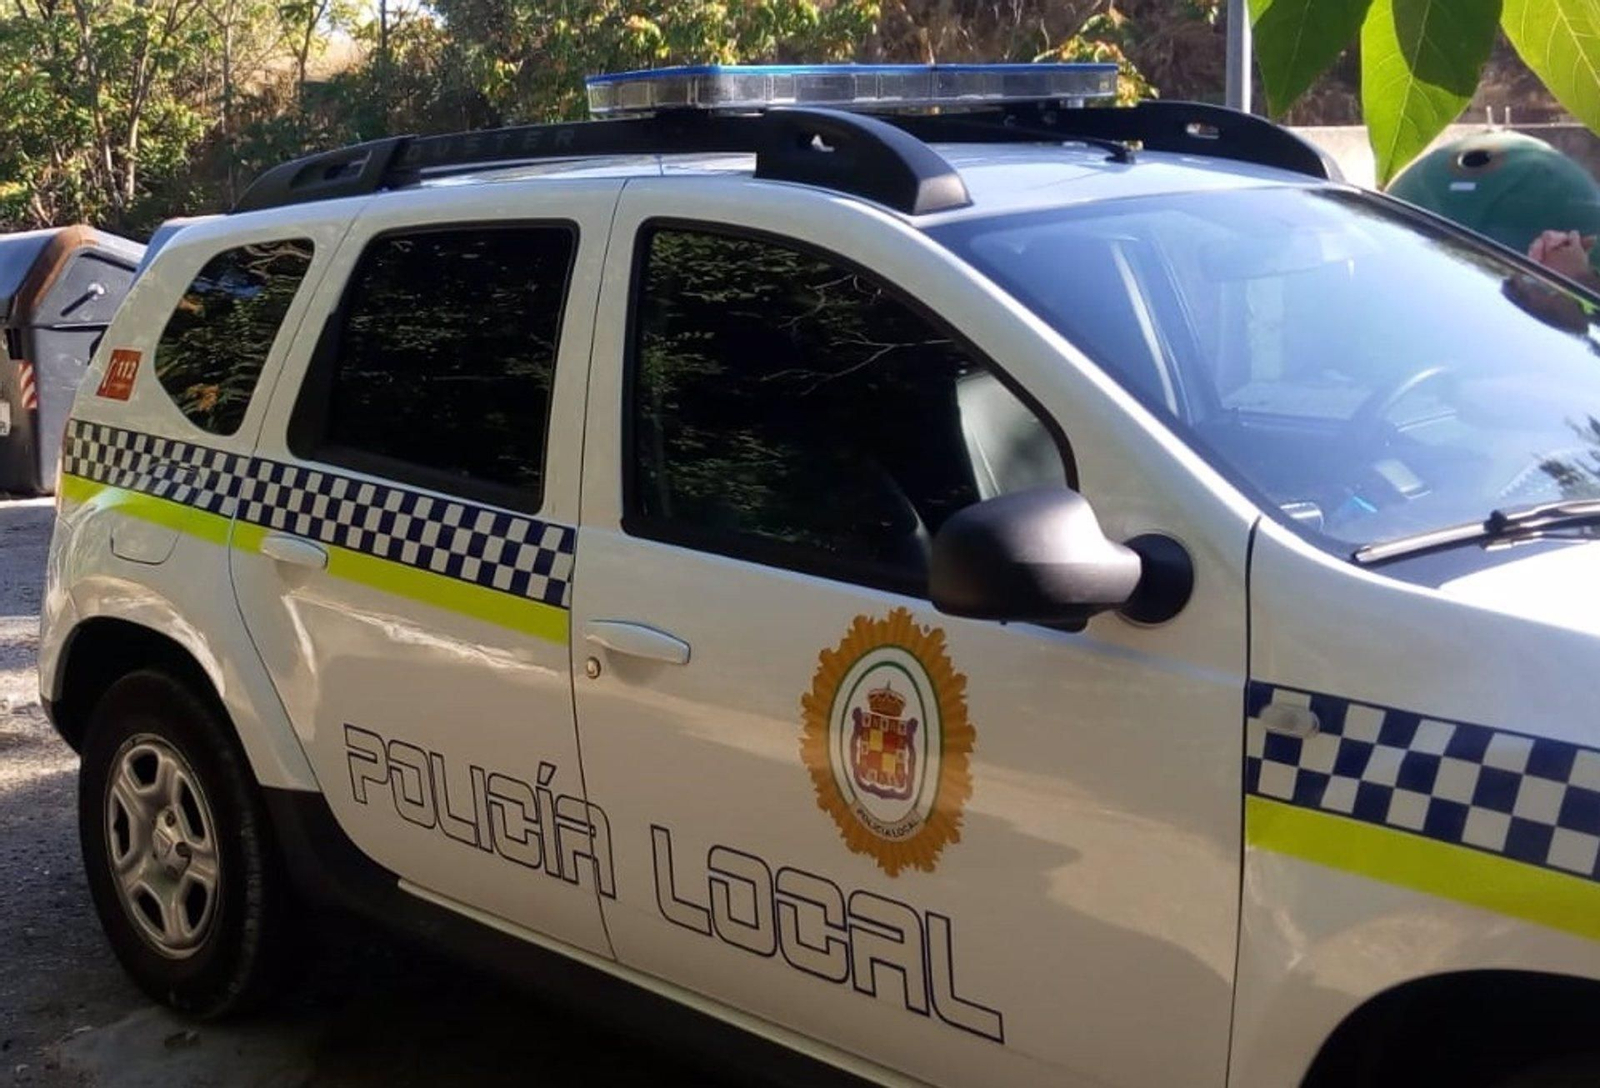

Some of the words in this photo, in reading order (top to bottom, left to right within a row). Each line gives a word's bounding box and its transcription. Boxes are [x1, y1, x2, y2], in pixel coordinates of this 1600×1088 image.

[117, 360, 137, 379] 112
[344, 723, 617, 900] POLICÍA
[651, 824, 1004, 1044] LOCAL
